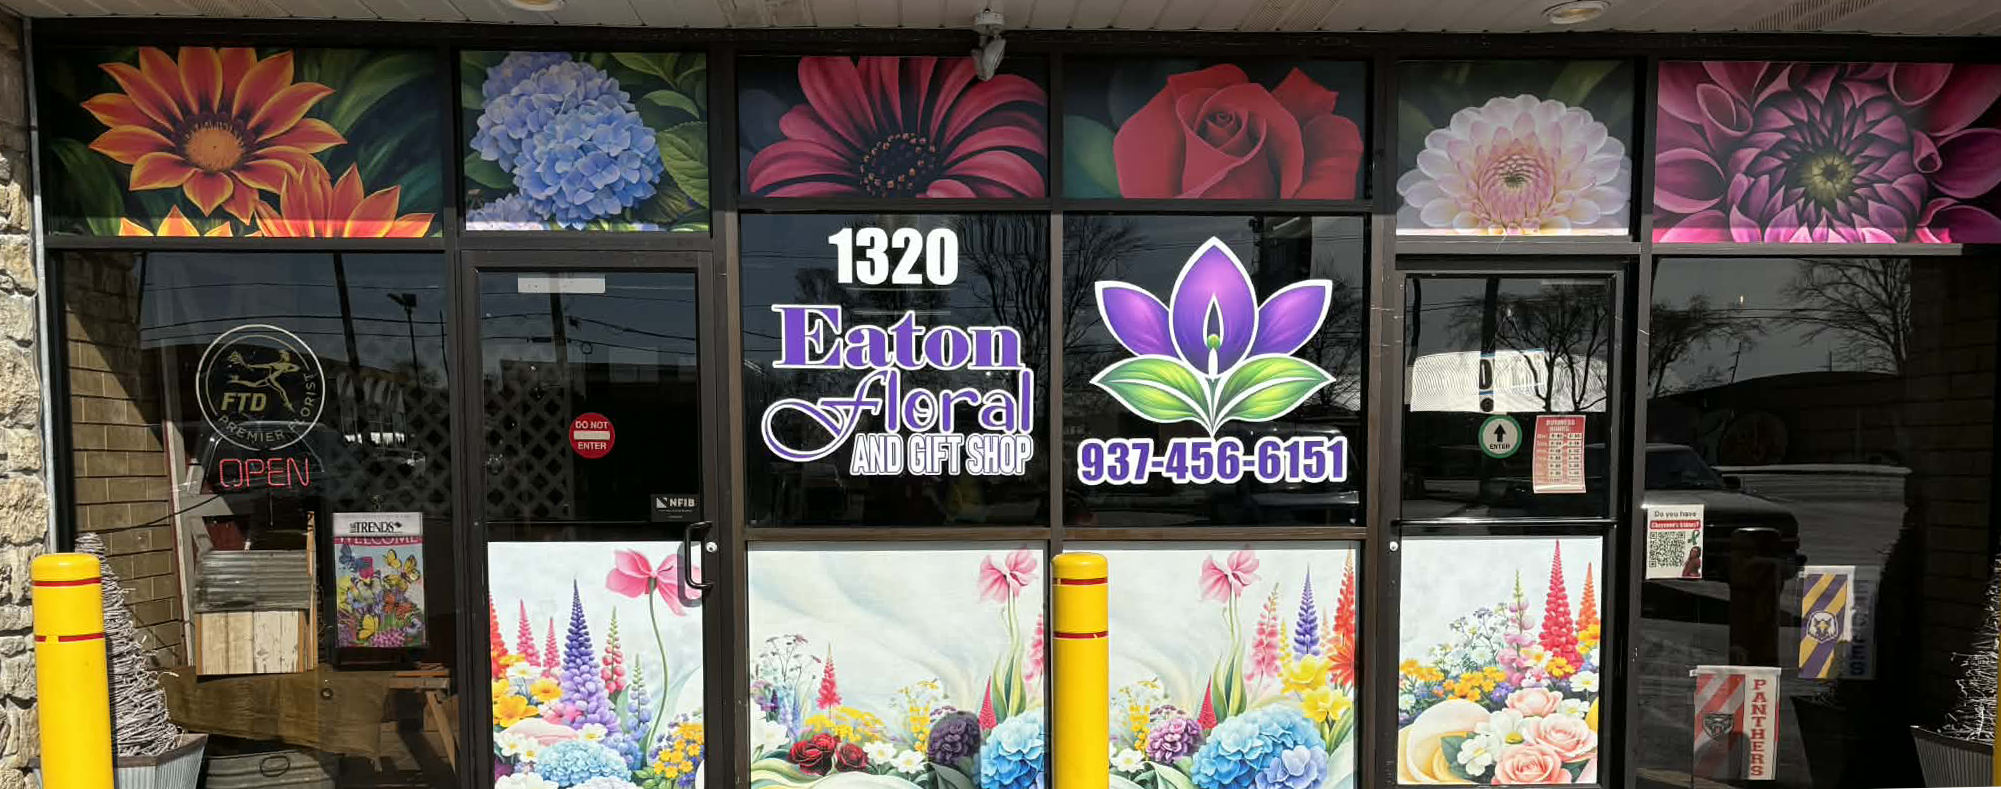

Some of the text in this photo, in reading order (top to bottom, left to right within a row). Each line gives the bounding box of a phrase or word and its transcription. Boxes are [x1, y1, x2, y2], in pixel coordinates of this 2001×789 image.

[828, 227, 959, 286] 1320
[771, 303, 1026, 371] Eaton
[220, 392, 267, 412] FTD
[288, 373, 316, 431] FLORIST
[218, 414, 285, 442] PREMIER
[575, 420, 609, 429] DO NOT
[577, 441, 607, 450] ENTER
[850, 433, 1034, 475] AND GIFT SHOP
[1078, 437, 1348, 485] 937-456-6151
[219, 457, 310, 489] OPEN
[669, 498, 695, 507] NFIB
[355, 521, 395, 533] TRENDS
[1750, 679, 1767, 776] PANTHERS
